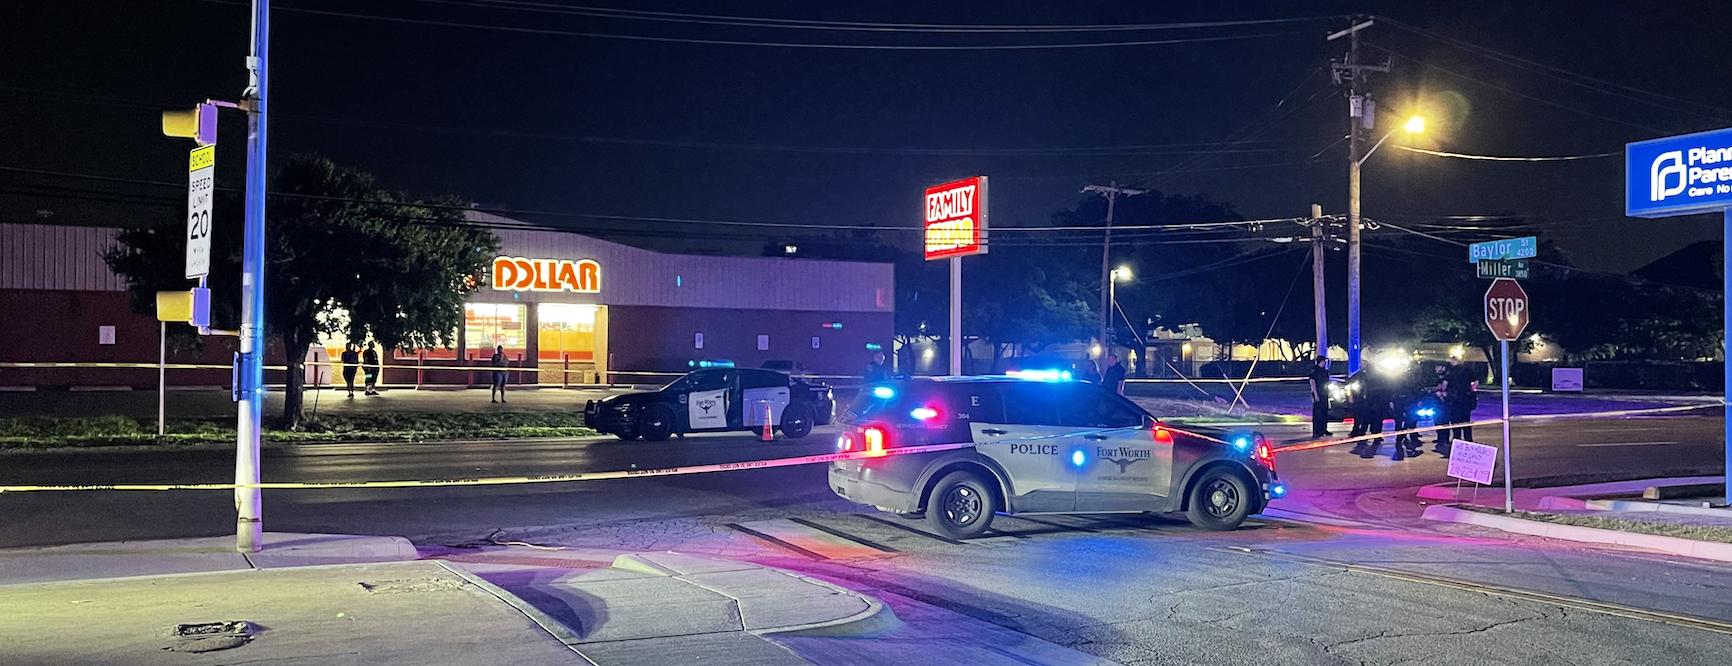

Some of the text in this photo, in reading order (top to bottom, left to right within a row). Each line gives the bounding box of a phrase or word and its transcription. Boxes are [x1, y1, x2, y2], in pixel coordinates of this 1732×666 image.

[192, 151, 212, 167] SCHOOL
[1688, 167, 1732, 185] Pare
[191, 177, 211, 192] SPEED
[1688, 184, 1730, 197] Care No
[193, 194, 209, 208] LIMIT
[928, 185, 975, 222] FAMILY
[191, 209, 208, 239] 20
[1473, 242, 1511, 260] Baylor
[1516, 247, 1534, 257] 4200
[494, 258, 599, 292] DOLLAR
[1481, 261, 1511, 276] Miller
[1489, 297, 1524, 321] STOP
[1010, 443, 1059, 456] POLICE
[1097, 446, 1150, 459] FORT WORTH
